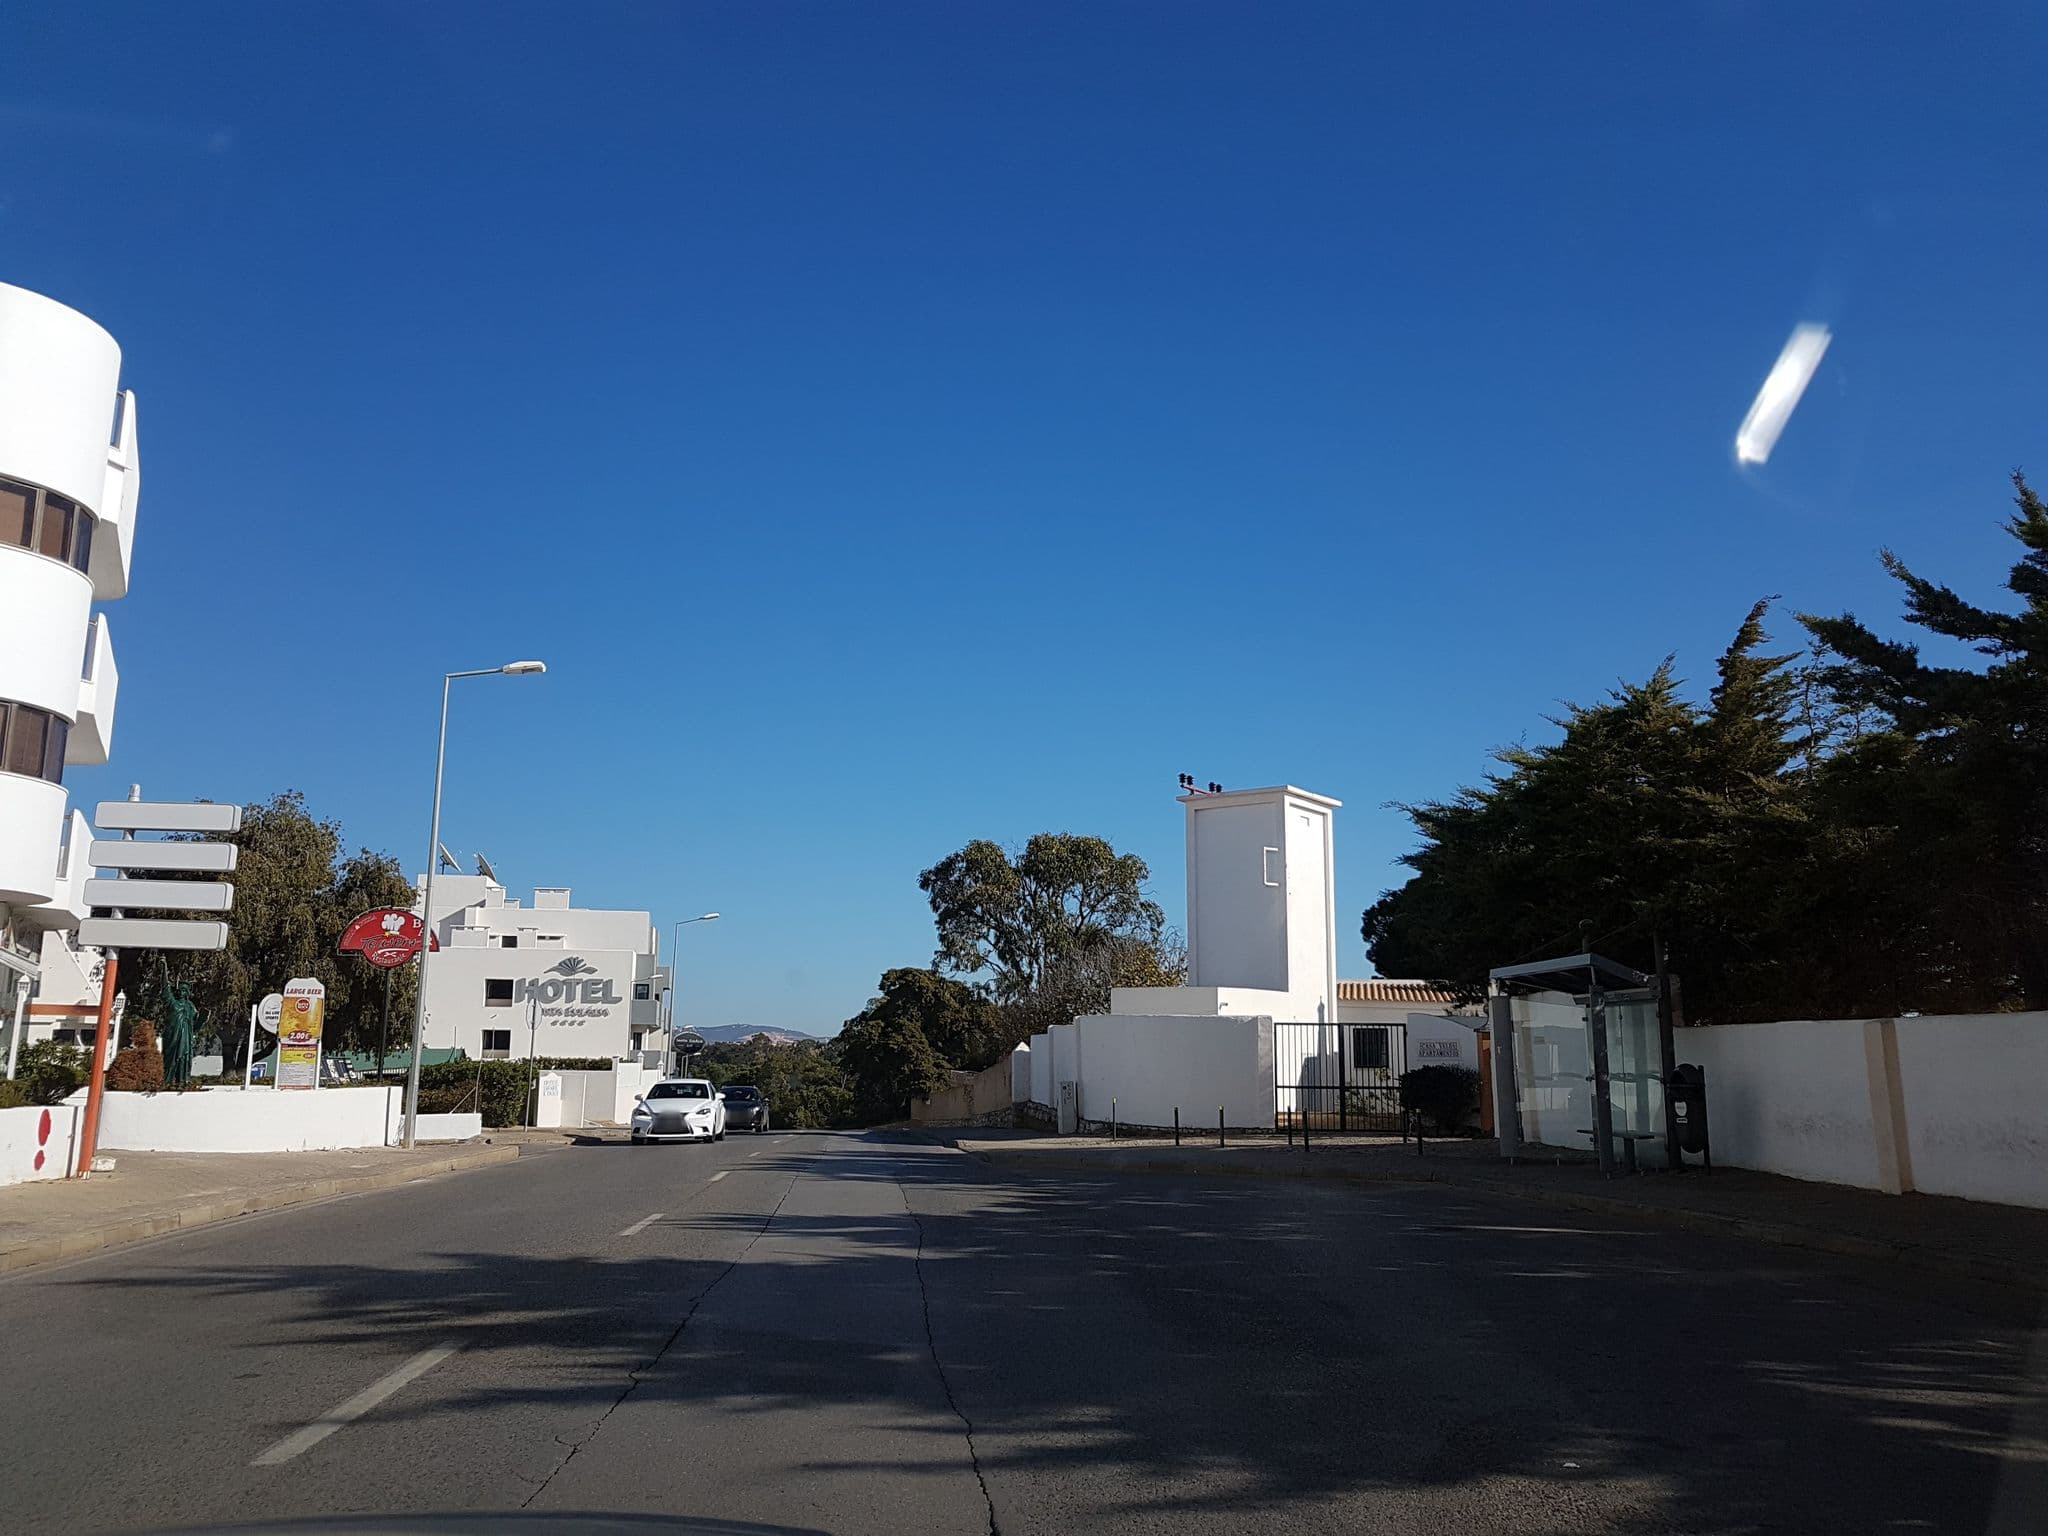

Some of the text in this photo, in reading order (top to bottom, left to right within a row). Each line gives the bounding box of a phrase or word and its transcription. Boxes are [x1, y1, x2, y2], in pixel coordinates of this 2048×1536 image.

[286, 987, 322, 995] LARGE BEER
[514, 978, 622, 1004] HOTEL
